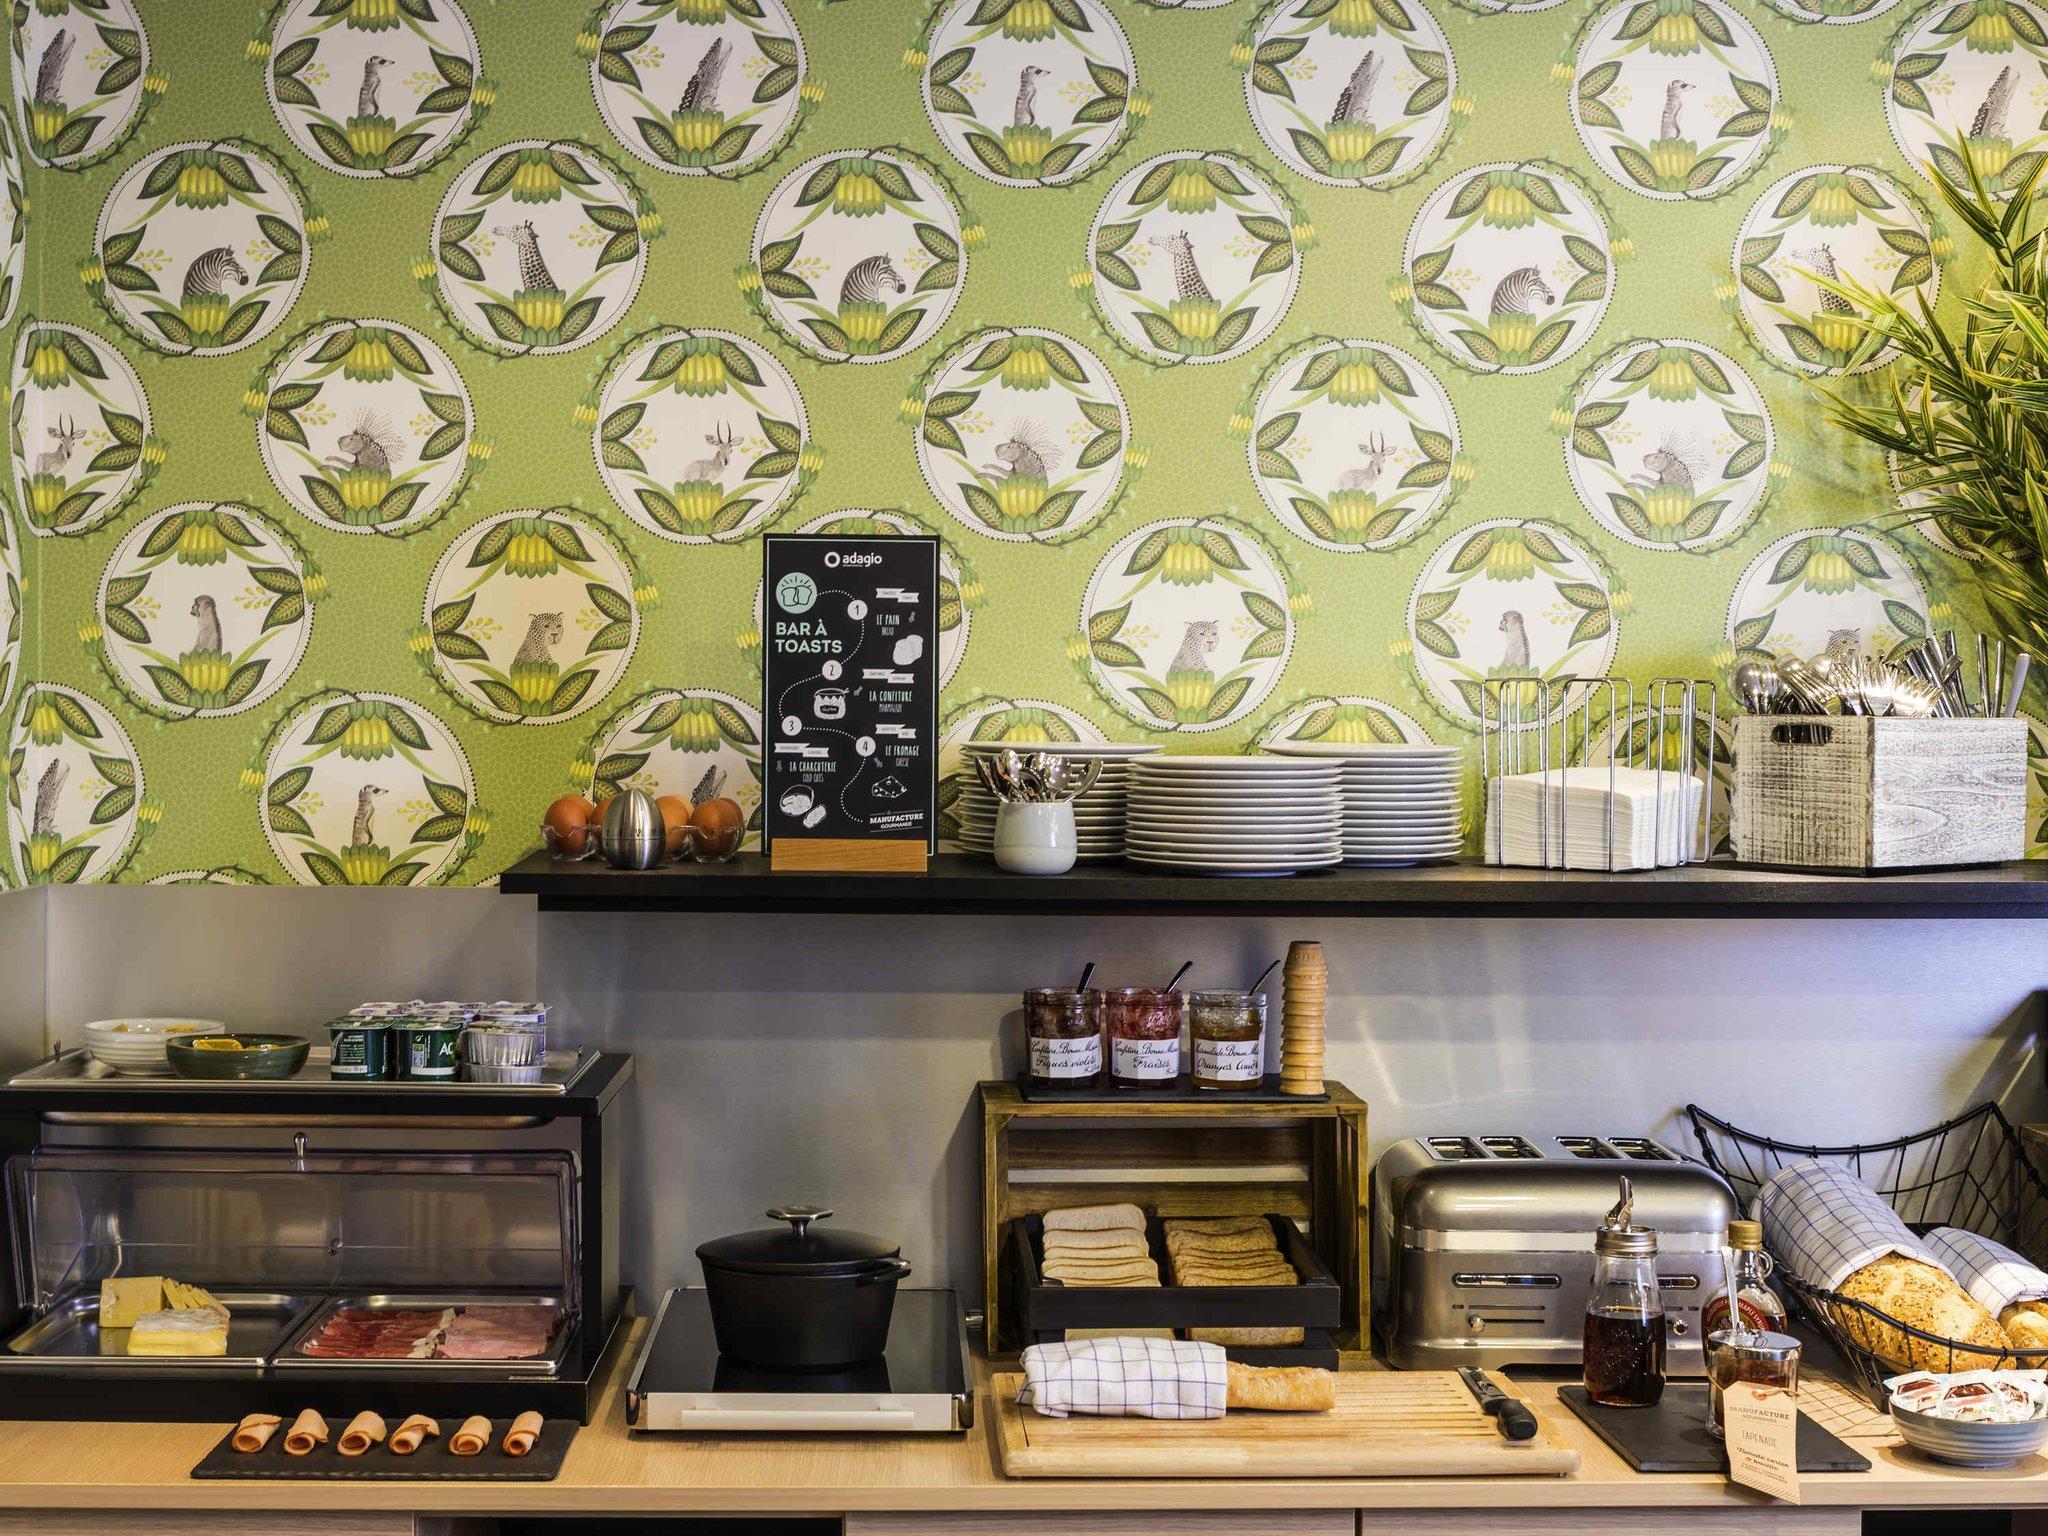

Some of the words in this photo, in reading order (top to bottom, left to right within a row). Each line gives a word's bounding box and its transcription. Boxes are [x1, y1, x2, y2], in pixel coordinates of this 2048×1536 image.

[842, 551, 882, 567] adagio
[855, 604, 860, 616] 1
[876, 614, 883, 626] LE
[885, 614, 900, 626] PAIN
[776, 621, 811, 636] BAR
[814, 618, 828, 636] À
[775, 639, 843, 654] TOASTS
[829, 664, 835, 677] 2
[869, 690, 878, 702] LA
[879, 690, 913, 702] CONFITURE
[788, 719, 794, 732] 3
[862, 740, 868, 752] 4
[885, 744, 892, 756] LE
[893, 744, 920, 756] FROMAGE
[789, 761, 797, 772] LA
[799, 761, 837, 772] CHARCUTERIE
[869, 812, 924, 824] MANUFACTURE
[880, 821, 912, 829] GOURMANDE
[1133, 1055, 1170, 1069] Fraises
[1729, 1406, 1790, 1420] MANUFACTURE
